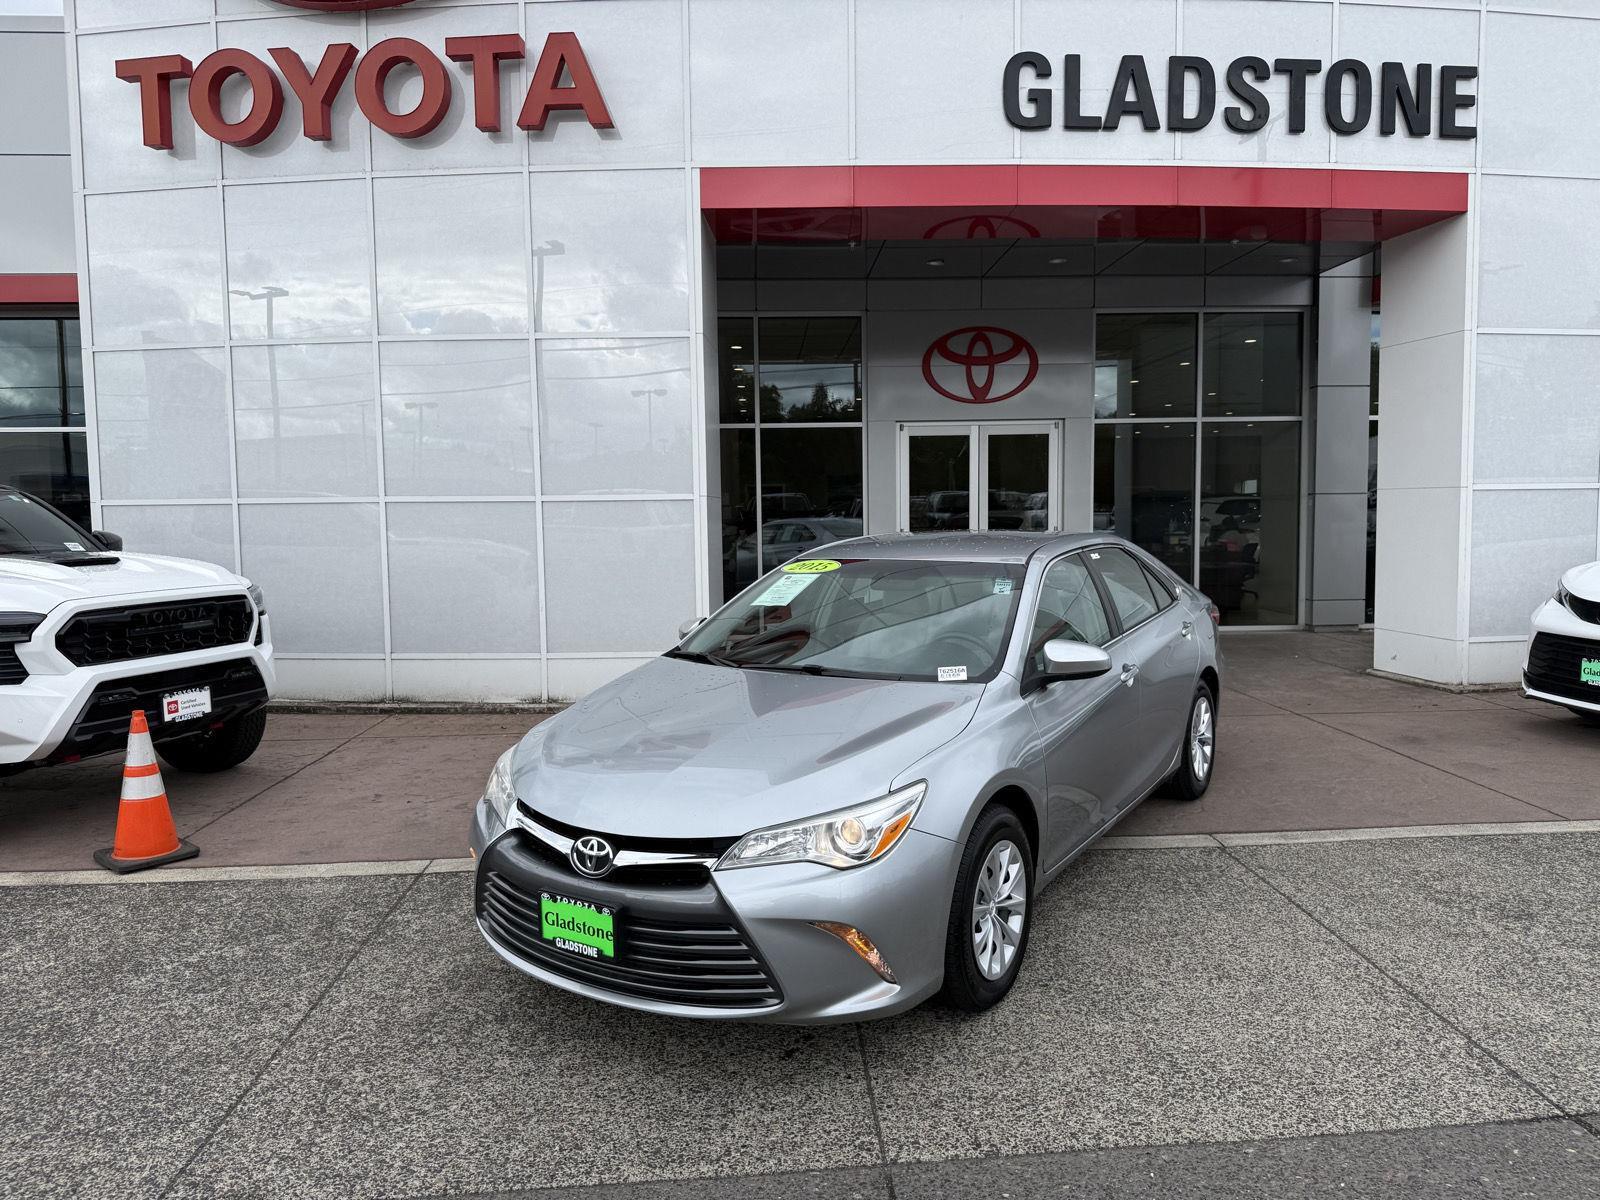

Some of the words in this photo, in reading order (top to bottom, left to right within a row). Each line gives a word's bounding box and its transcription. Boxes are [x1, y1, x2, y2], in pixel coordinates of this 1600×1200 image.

[115, 32, 615, 150] TOYOTA
[1003, 51, 1477, 138] GLADSTONE
[787, 562, 835, 571] 2015
[142, 607, 207, 625] TOYOTA
[173, 687, 200, 696] TOYOTA
[556, 896, 597, 911] TOYOTA
[545, 912, 613, 941] Gladstone
[556, 938, 598, 957] GLADSTONE
